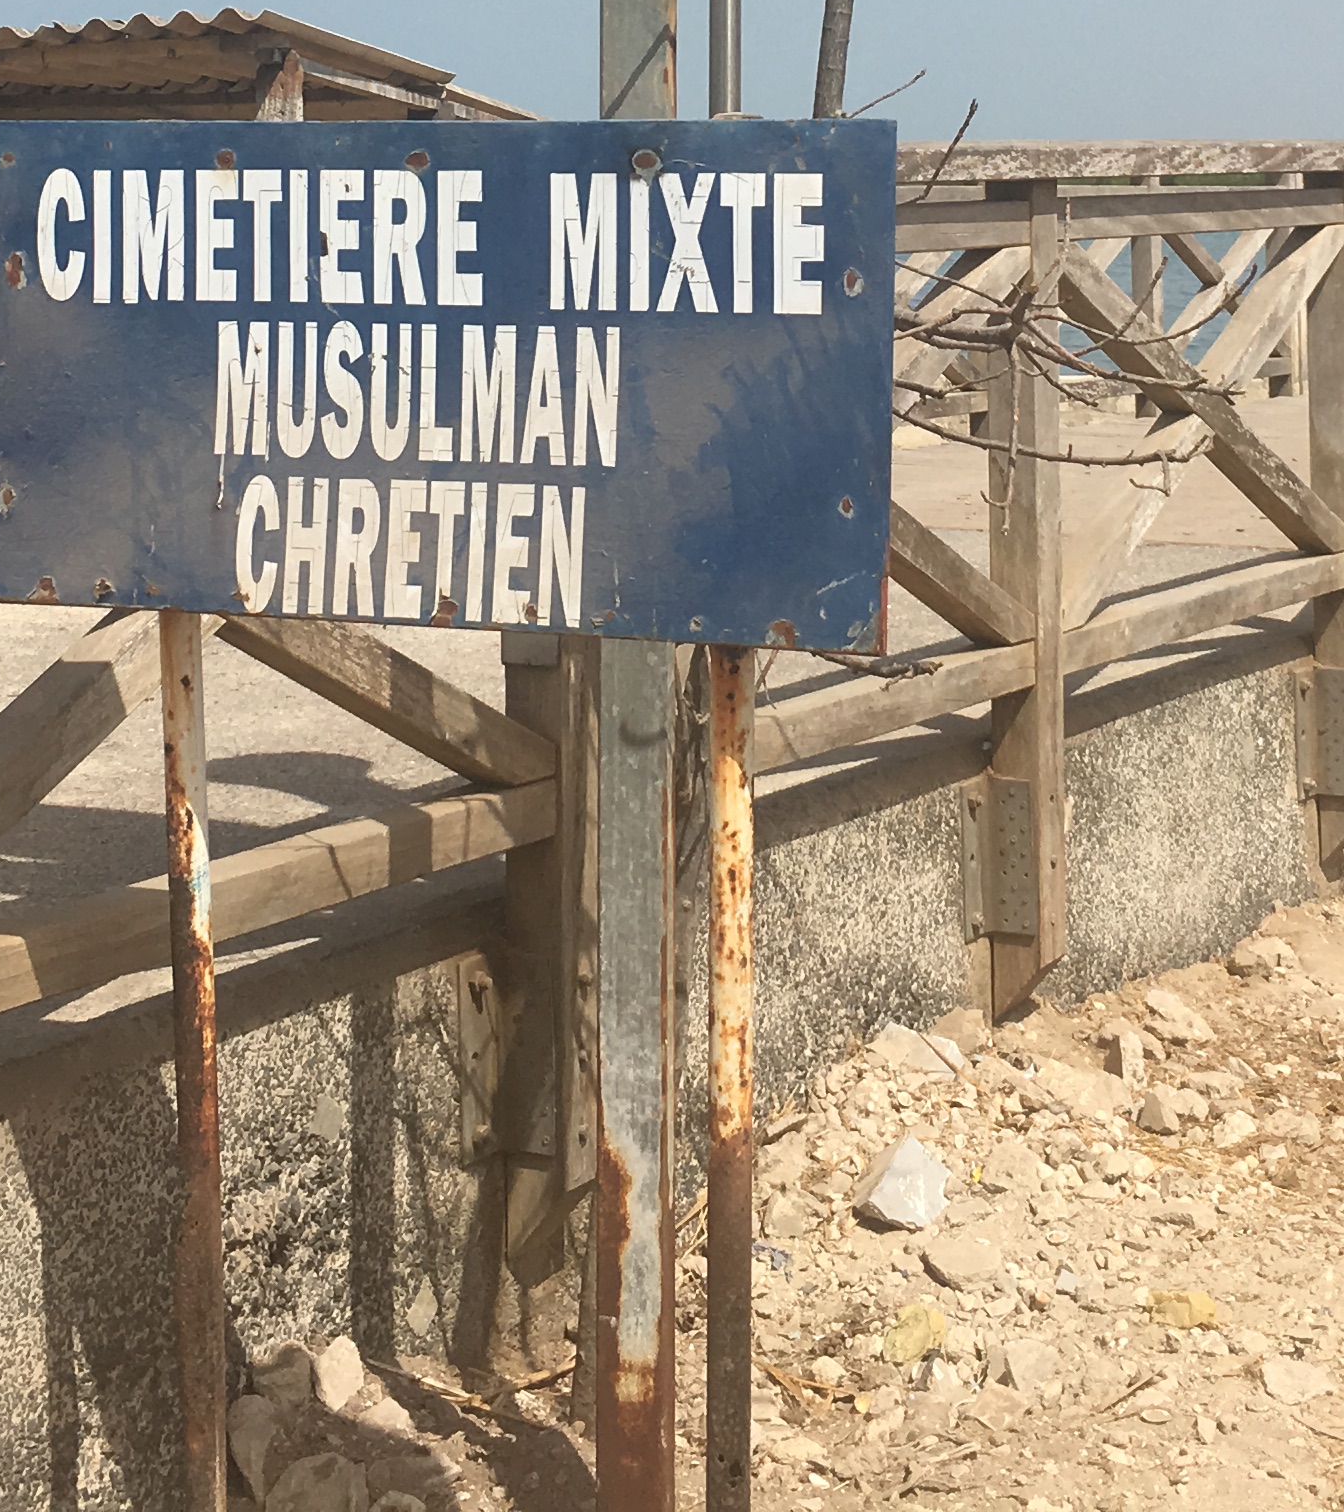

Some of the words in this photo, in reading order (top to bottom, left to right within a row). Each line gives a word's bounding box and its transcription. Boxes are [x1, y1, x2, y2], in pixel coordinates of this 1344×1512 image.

[36, 167, 485, 307] CIMETIERE
[549, 171, 826, 315] MIXTE
[214, 320, 621, 468] MUSULMAN
[235, 474, 586, 628] CHRETIEN
